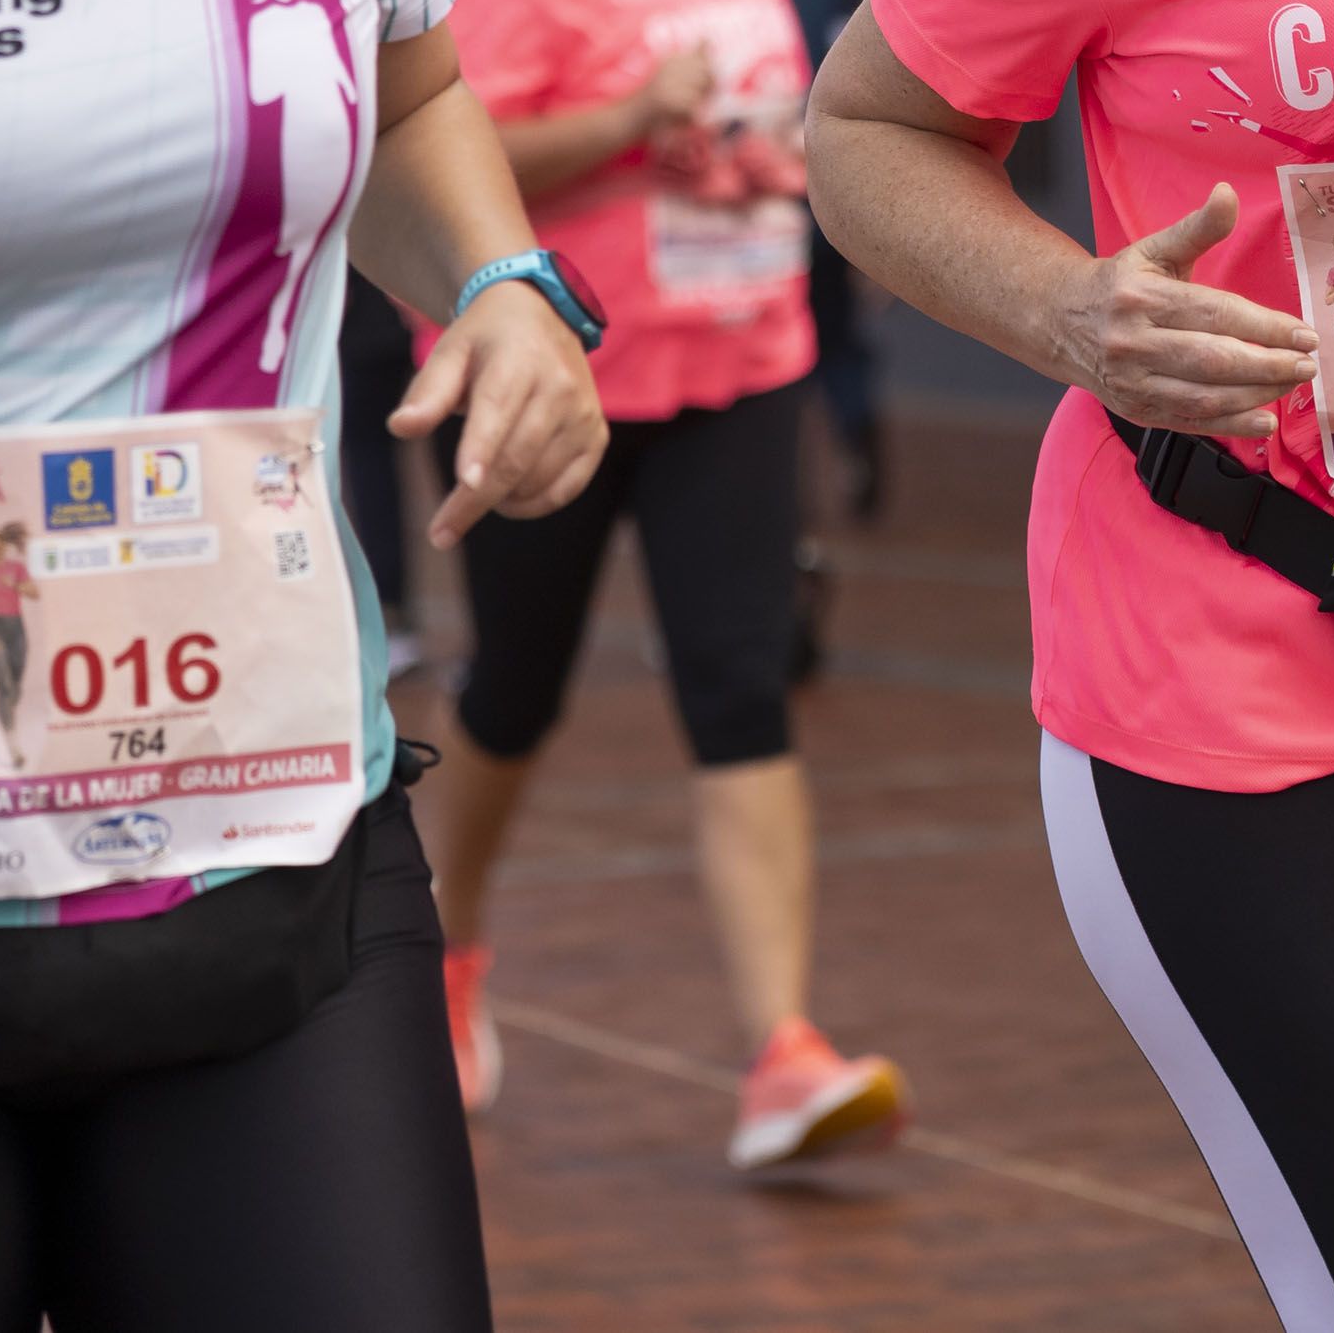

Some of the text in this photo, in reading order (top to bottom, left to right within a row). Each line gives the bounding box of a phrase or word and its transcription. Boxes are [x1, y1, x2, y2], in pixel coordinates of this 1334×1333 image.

[49, 632, 222, 715] 016
[109, 727, 166, 761] 764
[55, 781, 83, 808] LA
[88, 772, 162, 804] MUJER
[178, 762, 239, 791] GRAN
[244, 752, 337, 785] CANARIA
